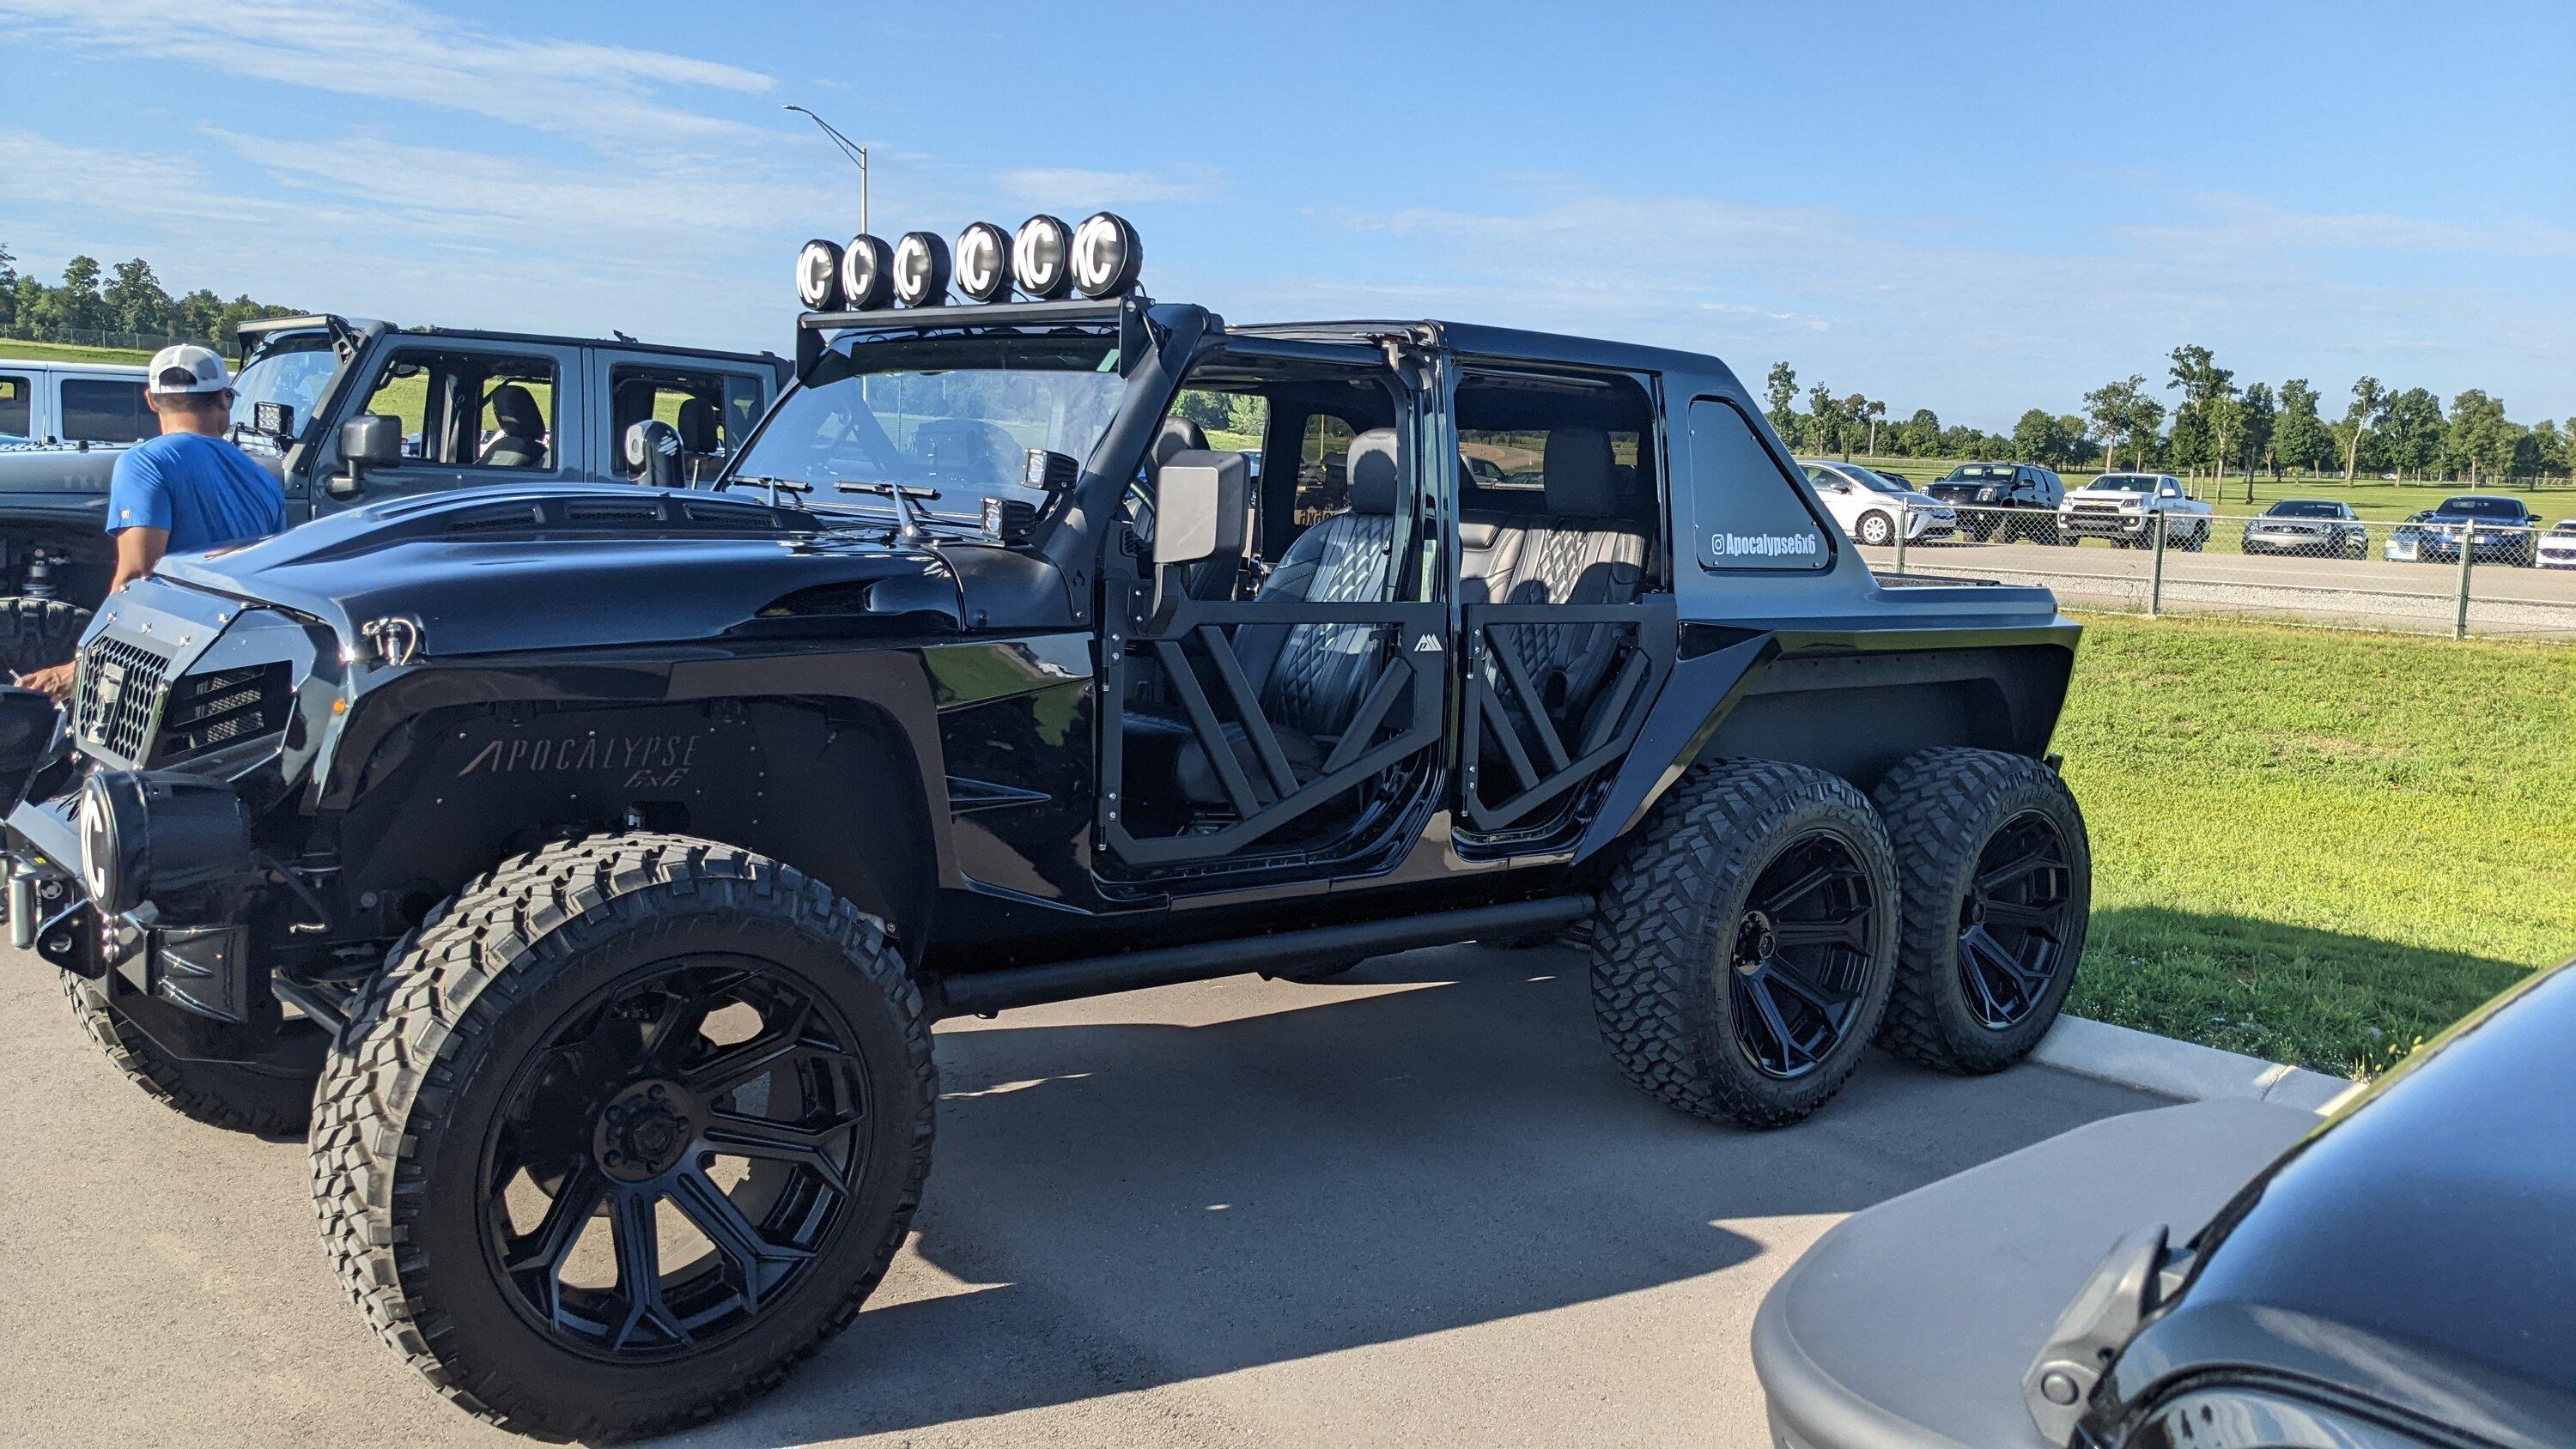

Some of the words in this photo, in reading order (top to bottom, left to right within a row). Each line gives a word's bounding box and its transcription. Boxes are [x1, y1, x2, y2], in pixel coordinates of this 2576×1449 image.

[955, 226, 993, 294] KC
[1013, 218, 1054, 289] KC
[1072, 215, 1117, 288] KC
[457, 736, 700, 777] APOCALYPSE
